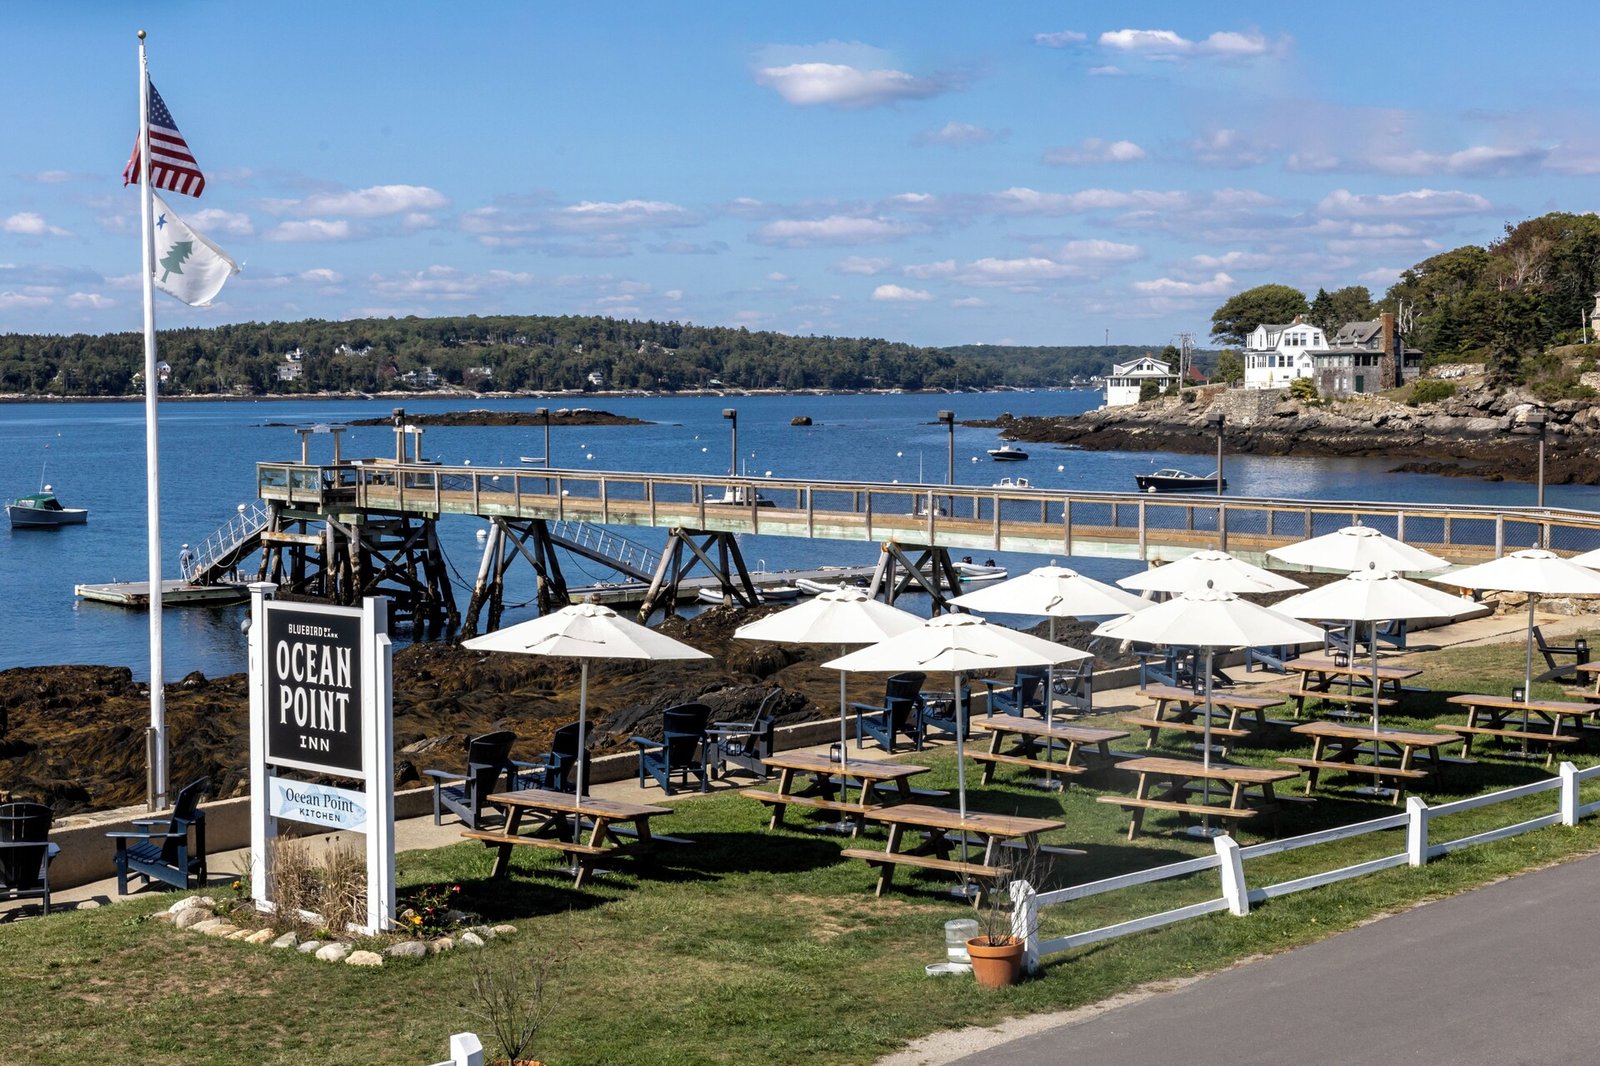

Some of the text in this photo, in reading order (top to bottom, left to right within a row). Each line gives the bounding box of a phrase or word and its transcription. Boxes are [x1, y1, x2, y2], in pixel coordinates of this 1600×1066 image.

[288, 624, 323, 637] BLUEBIRD
[276, 640, 352, 688] OCEAN
[280, 685, 350, 733] POINT
[300, 735, 330, 752] INN
[286, 788, 353, 813] Ocean Point
[299, 808, 341, 822] KITCHEN
